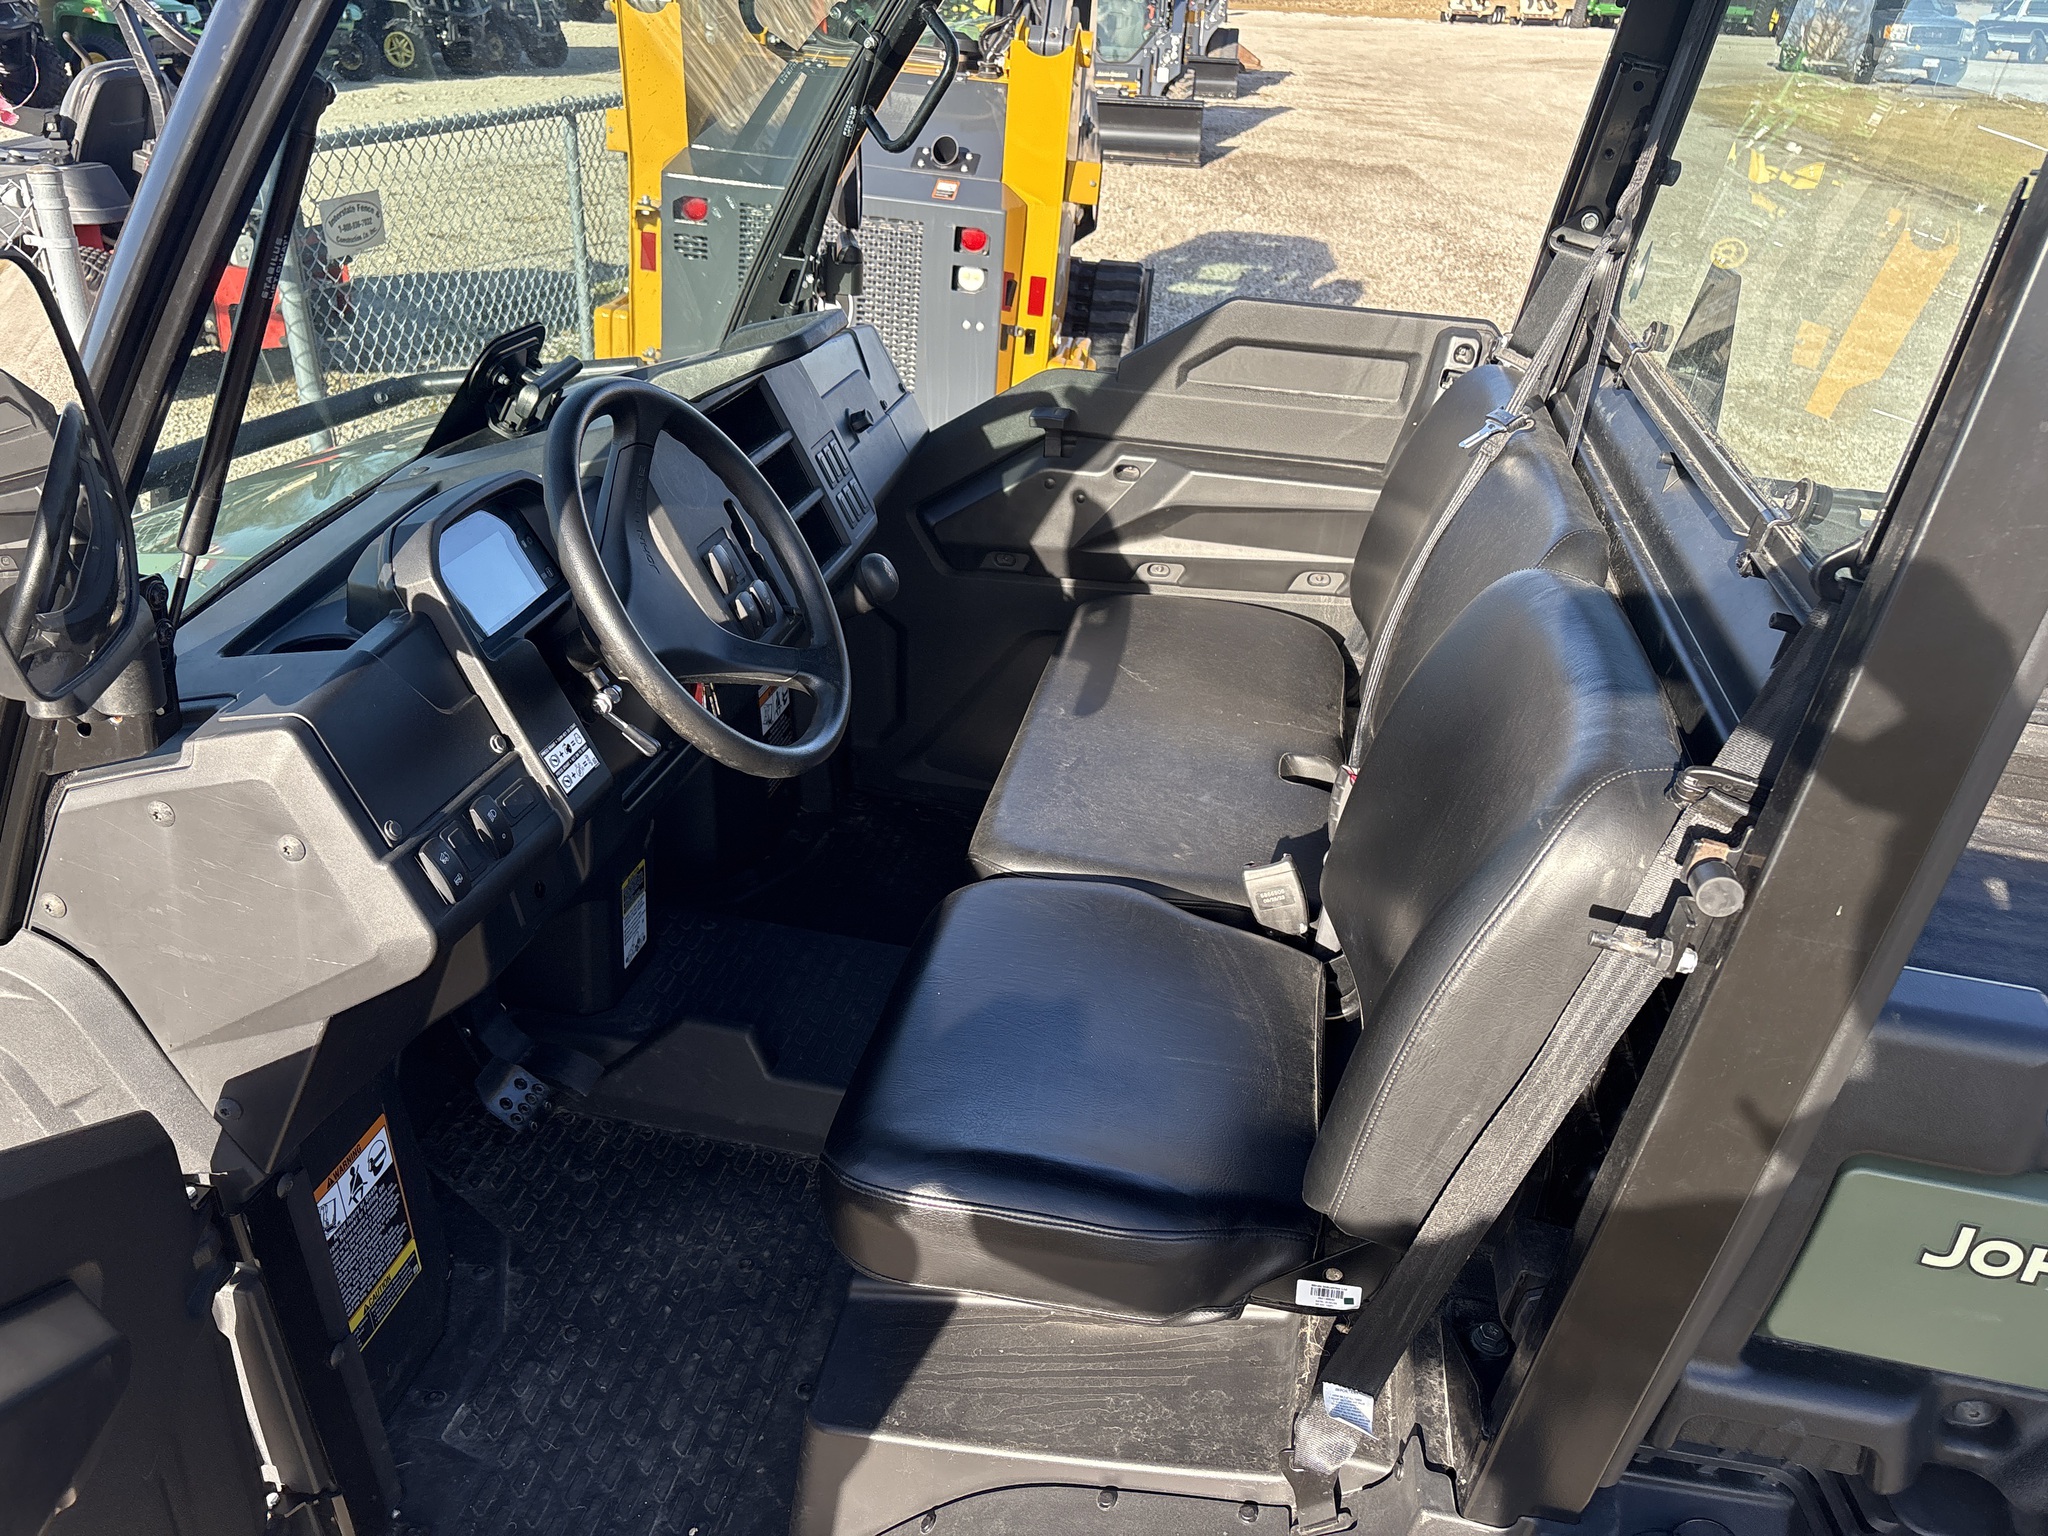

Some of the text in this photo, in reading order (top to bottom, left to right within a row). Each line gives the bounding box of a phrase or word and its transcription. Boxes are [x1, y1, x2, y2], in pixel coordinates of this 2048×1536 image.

[357, 203, 375, 214] Fence
[261, 237, 283, 299] STABILUS
[333, 1144, 361, 1181] WARNING
[332, 1222, 346, 1241] Avoid
[346, 1206, 359, 1226] Injury
[364, 1184, 377, 1203] Death
[368, 1273, 392, 1307] CAUTION
